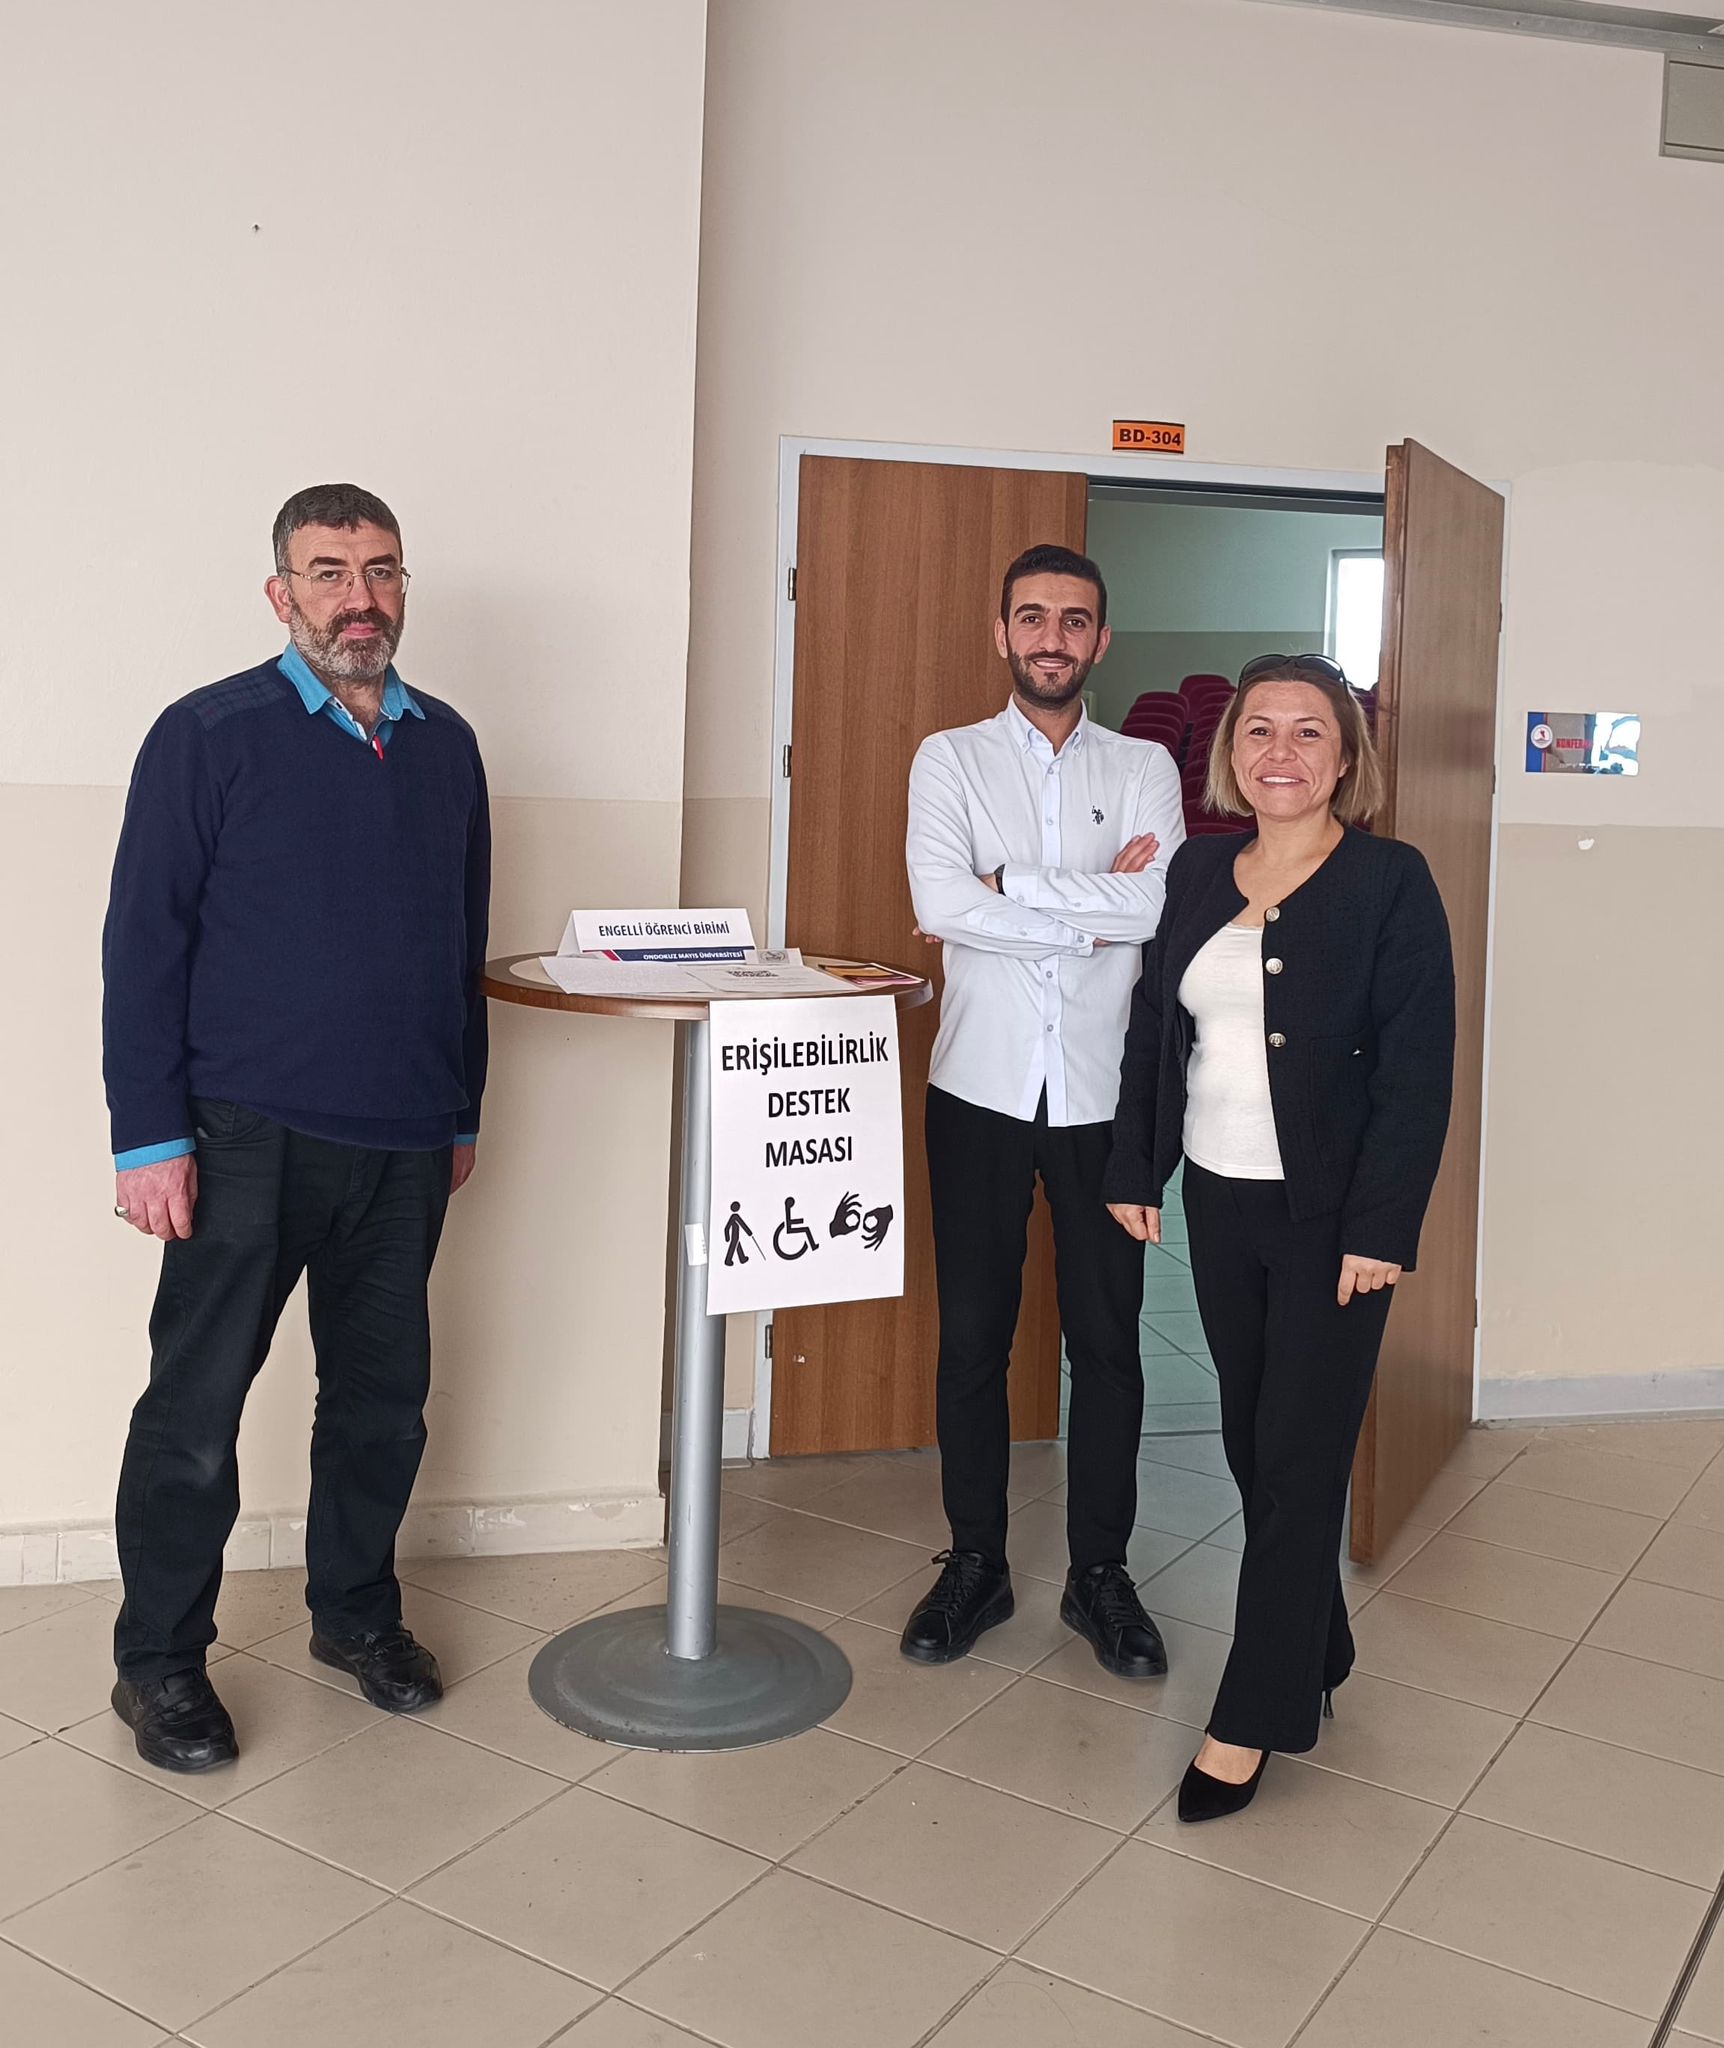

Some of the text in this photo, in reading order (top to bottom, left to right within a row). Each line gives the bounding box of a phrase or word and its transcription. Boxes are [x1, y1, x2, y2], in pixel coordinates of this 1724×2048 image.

[1119, 428, 1182, 446] BD-304
[599, 921, 730, 937] ENGELLİ ÖĞRENCİ BİRİMİ
[643, 949, 743, 961] ONDOKUZ MAYIS ÜNİVERSİTESİ
[721, 1031, 889, 1076] ERİŞİLEBİLİRLİK
[767, 1087, 851, 1118] DESTEK
[765, 1136, 853, 1168] MASASI
